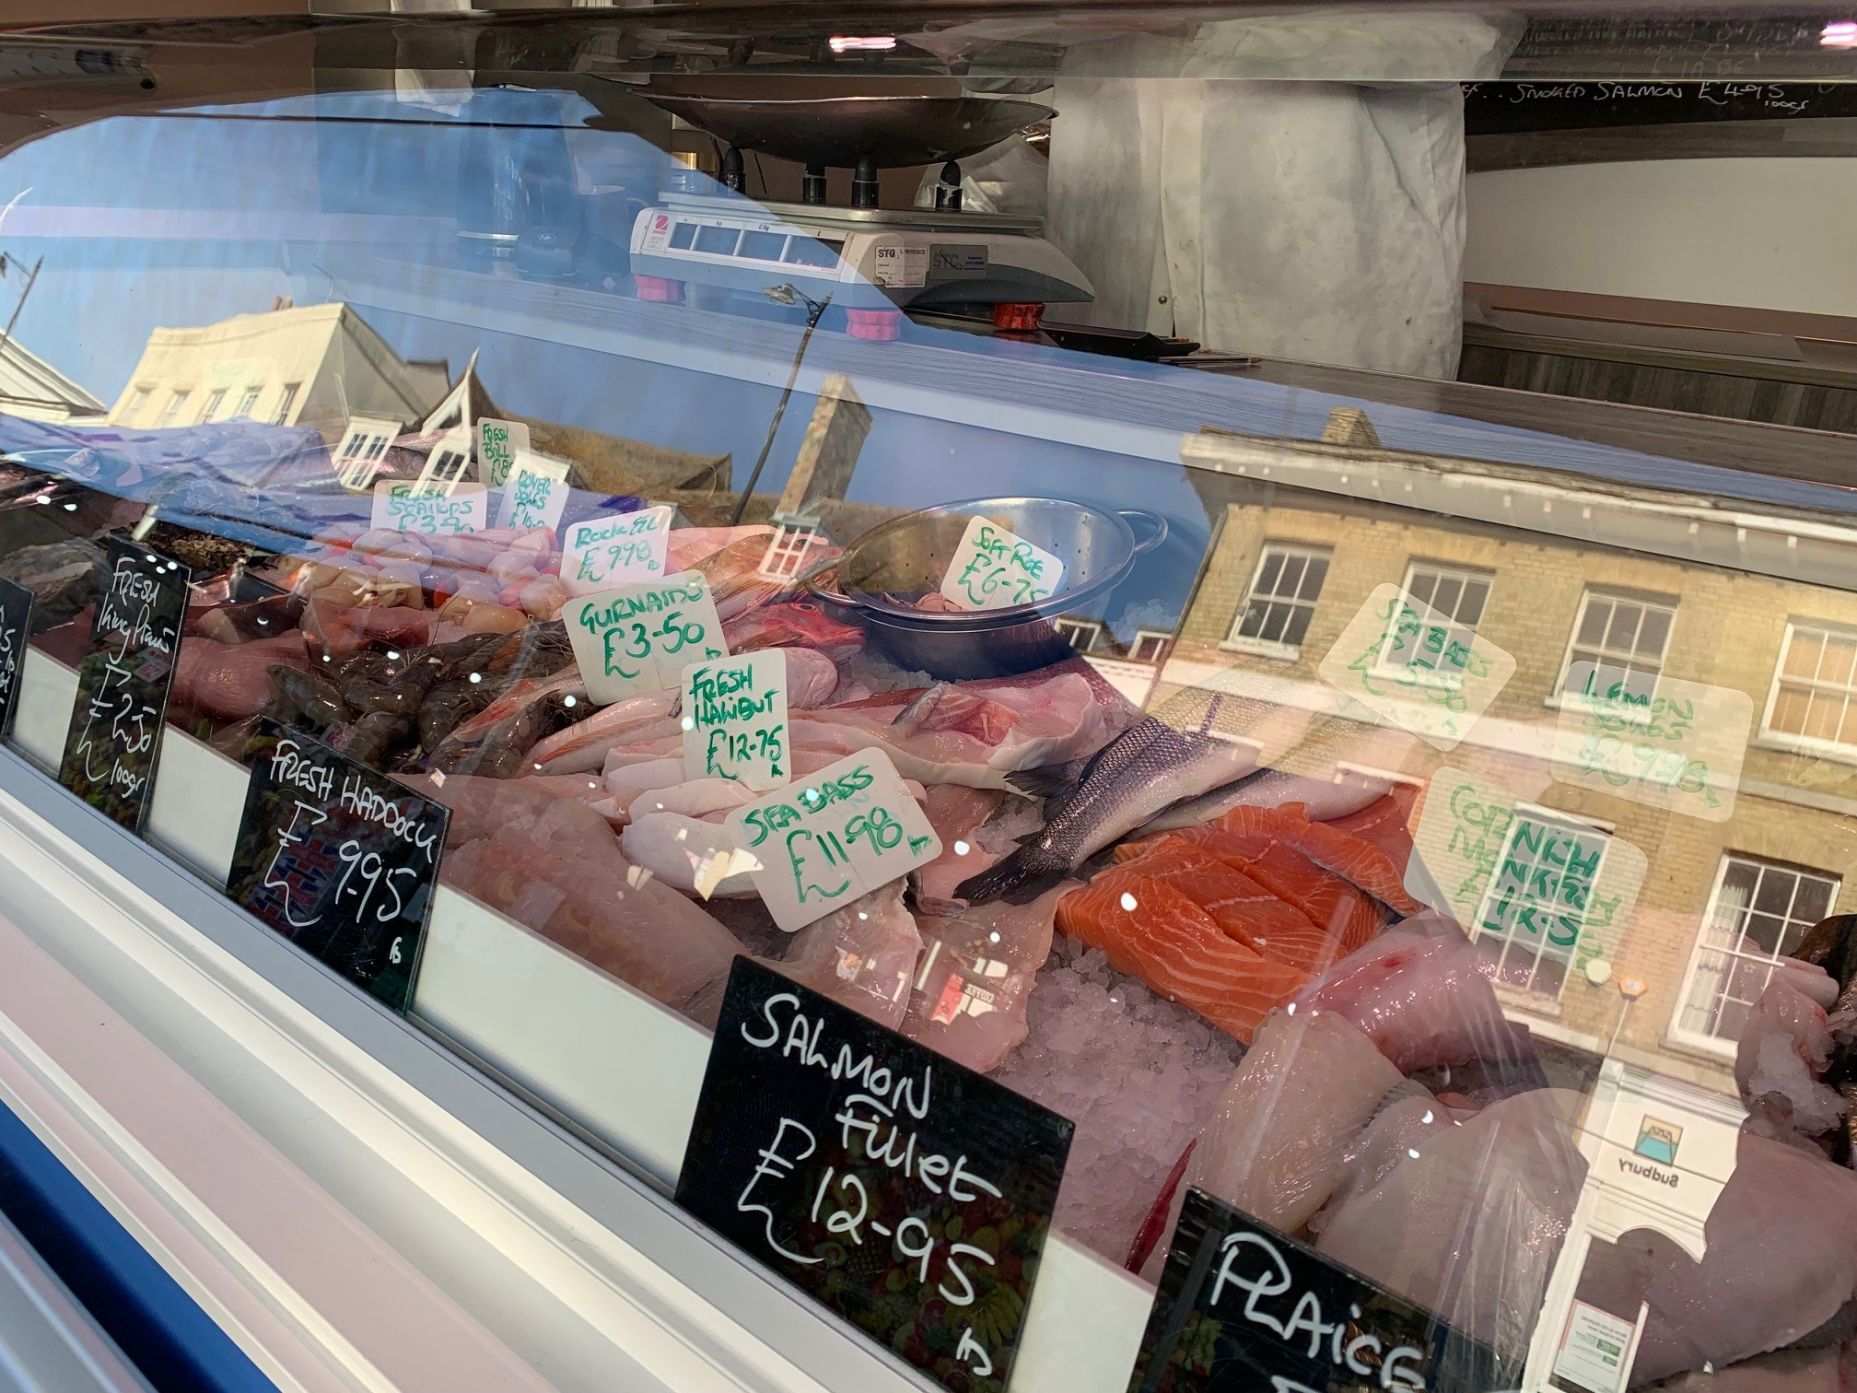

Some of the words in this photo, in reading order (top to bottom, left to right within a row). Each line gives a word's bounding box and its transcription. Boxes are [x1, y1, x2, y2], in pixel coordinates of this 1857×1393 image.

[1593, 81, 1683, 101] SALMON
[112, 556, 161, 608] FRESH
[689, 663, 754, 703] FRESH
[270, 739, 336, 801] FRESH
[340, 775, 438, 864] HADDOCK
[744, 803, 802, 847] SEA
[796, 765, 874, 814] BASS
[741, 993, 932, 1119] SALMON
